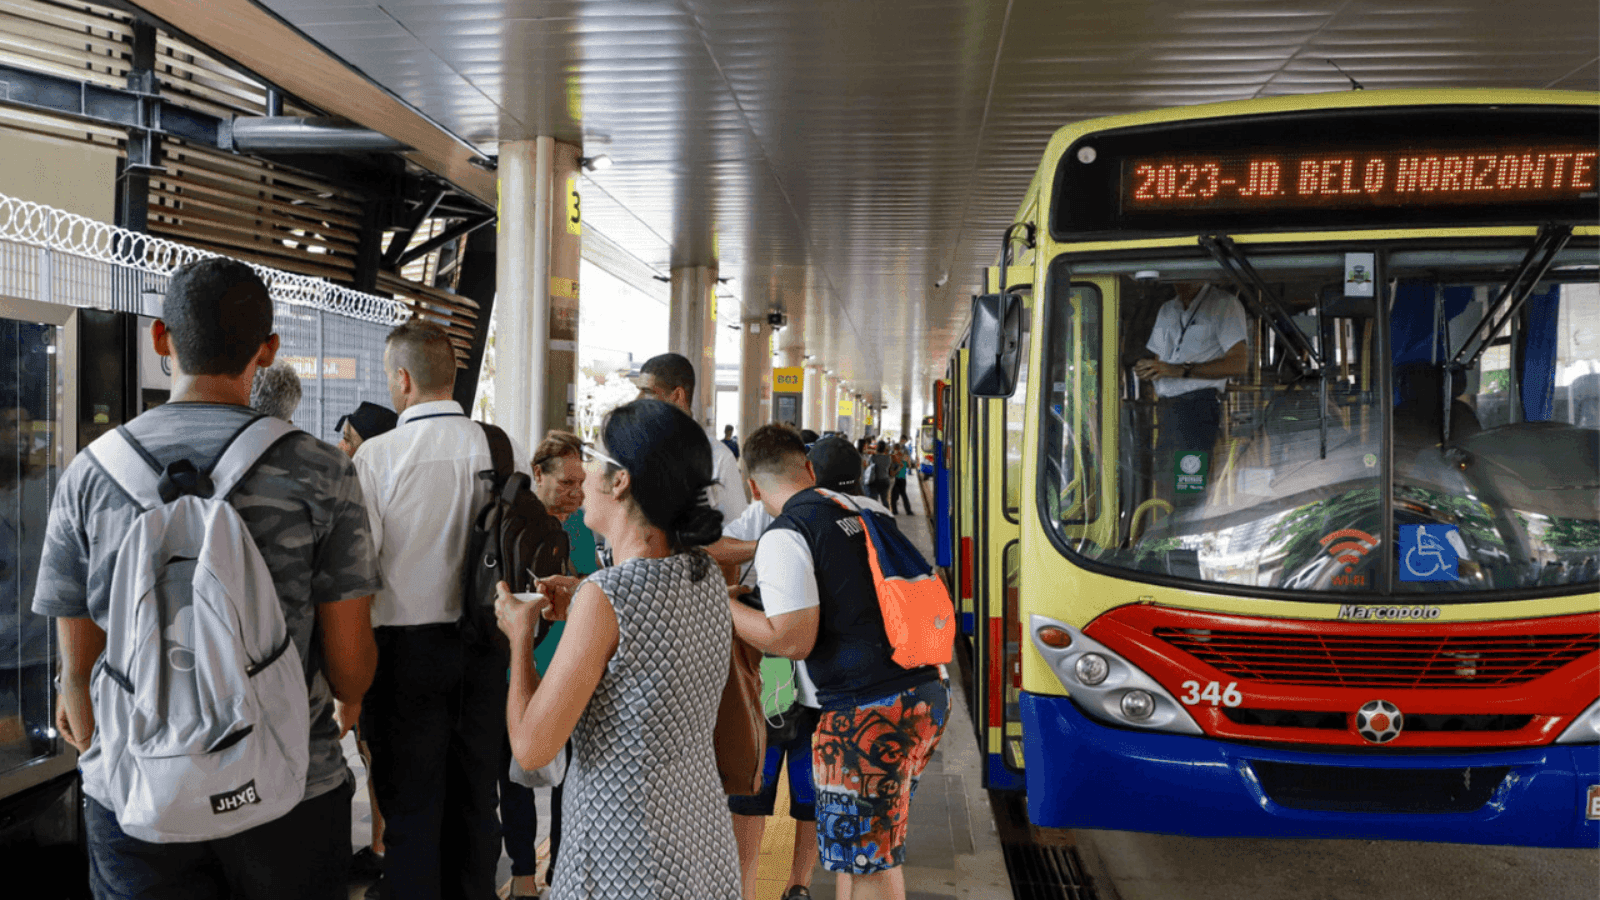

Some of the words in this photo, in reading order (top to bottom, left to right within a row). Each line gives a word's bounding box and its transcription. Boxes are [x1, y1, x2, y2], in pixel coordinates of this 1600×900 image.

[1135, 160, 1285, 199] 2023-JD.
[1299, 159, 1385, 195] BELO
[1395, 152, 1596, 192] HORIZONTE
[570, 190, 580, 223] 3
[777, 374, 798, 384] B03
[1338, 604, 1441, 620] Marcopolo
[1180, 680, 1242, 707] 346
